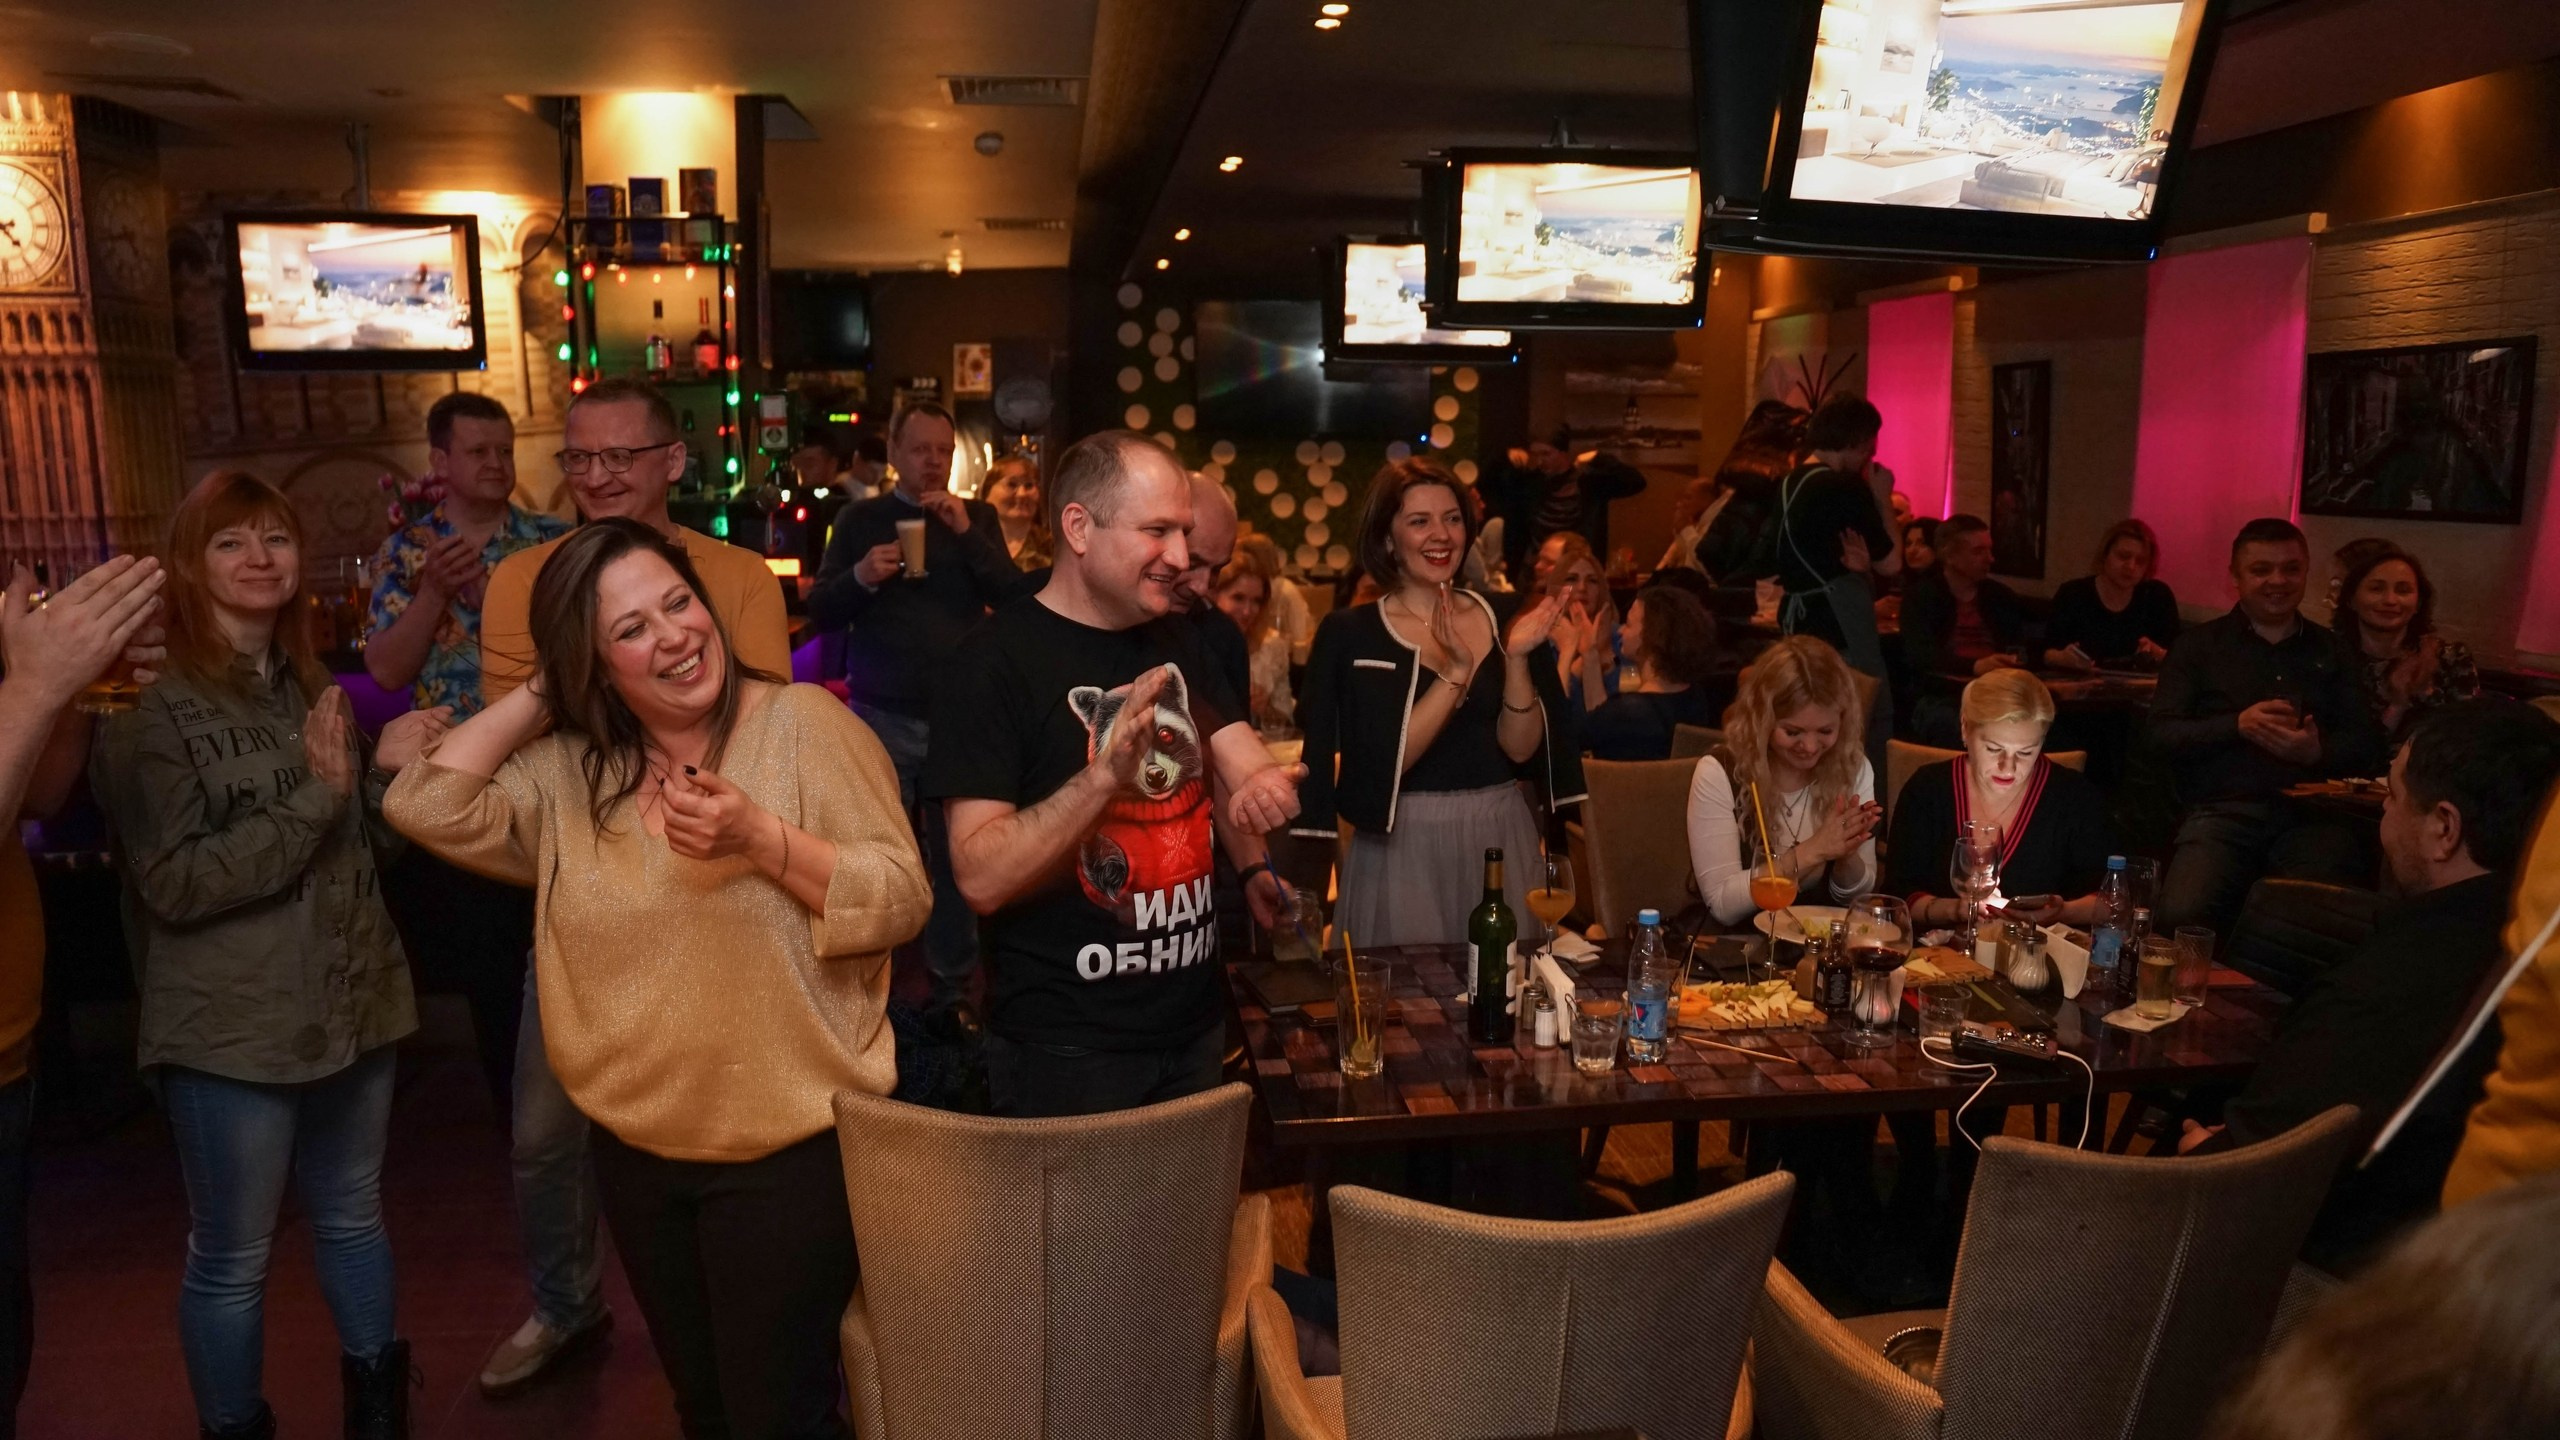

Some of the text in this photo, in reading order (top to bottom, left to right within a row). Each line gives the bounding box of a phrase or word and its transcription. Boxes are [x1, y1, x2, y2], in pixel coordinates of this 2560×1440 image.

[182, 710, 205, 722] THE
[184, 725, 281, 769] EVERY
[222, 777, 257, 810] IS
[1133, 873, 1213, 932] ИДИ
